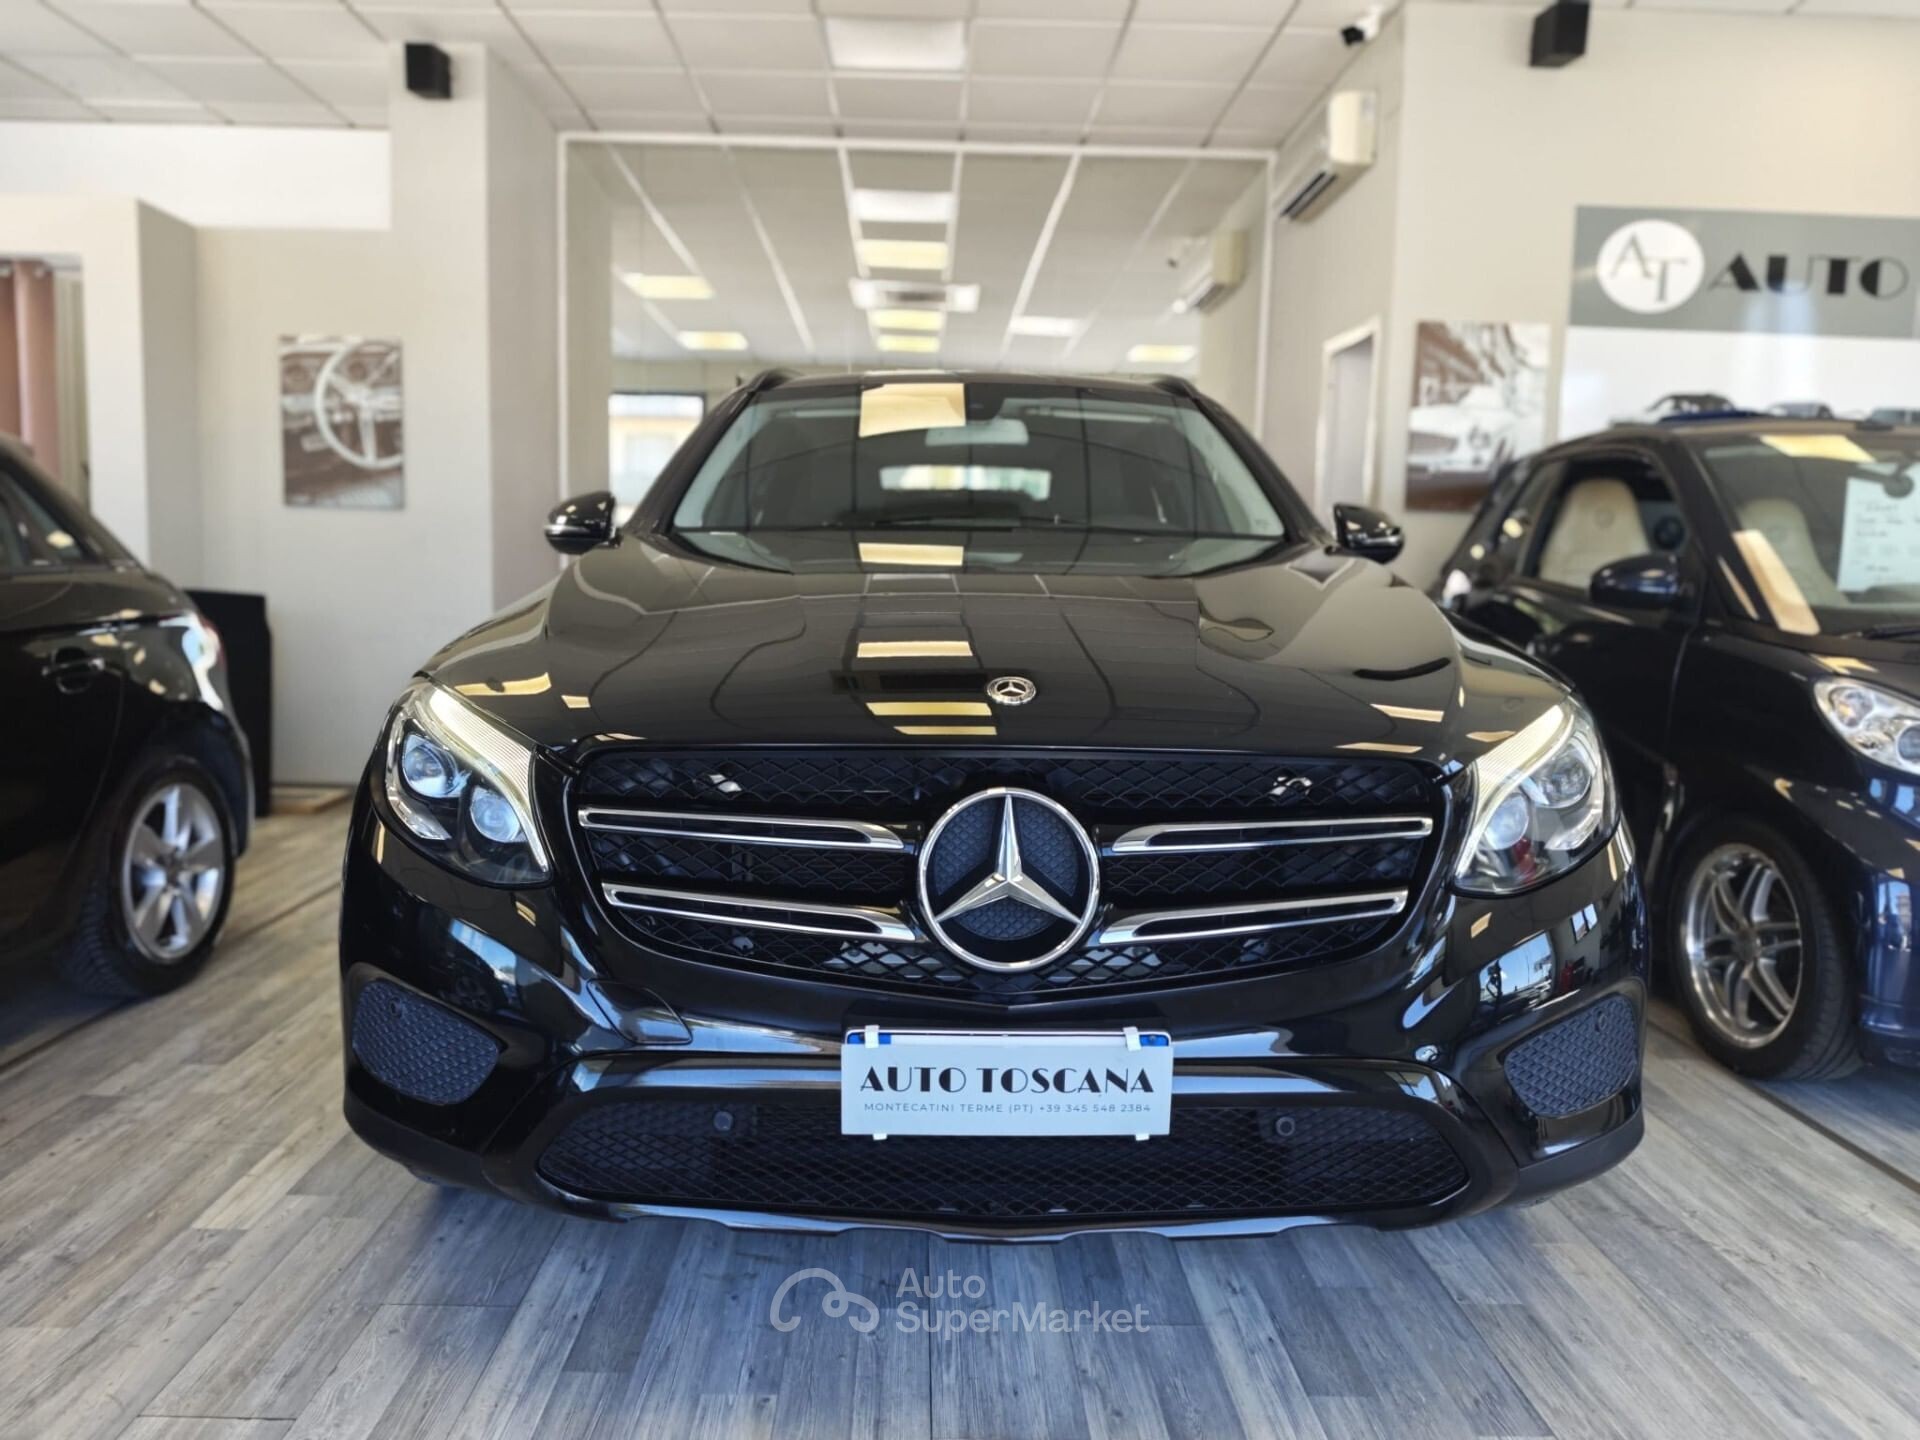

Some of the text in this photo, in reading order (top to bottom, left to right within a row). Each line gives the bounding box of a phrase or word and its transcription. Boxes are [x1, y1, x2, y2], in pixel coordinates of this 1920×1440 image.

[1707, 252, 1910, 300] AUTO
[860, 1065, 1155, 1094] AUTO TOSCANA
[863, 1102, 1152, 1115] MONTECATINI TERME (PT) +39 345 548 2384
